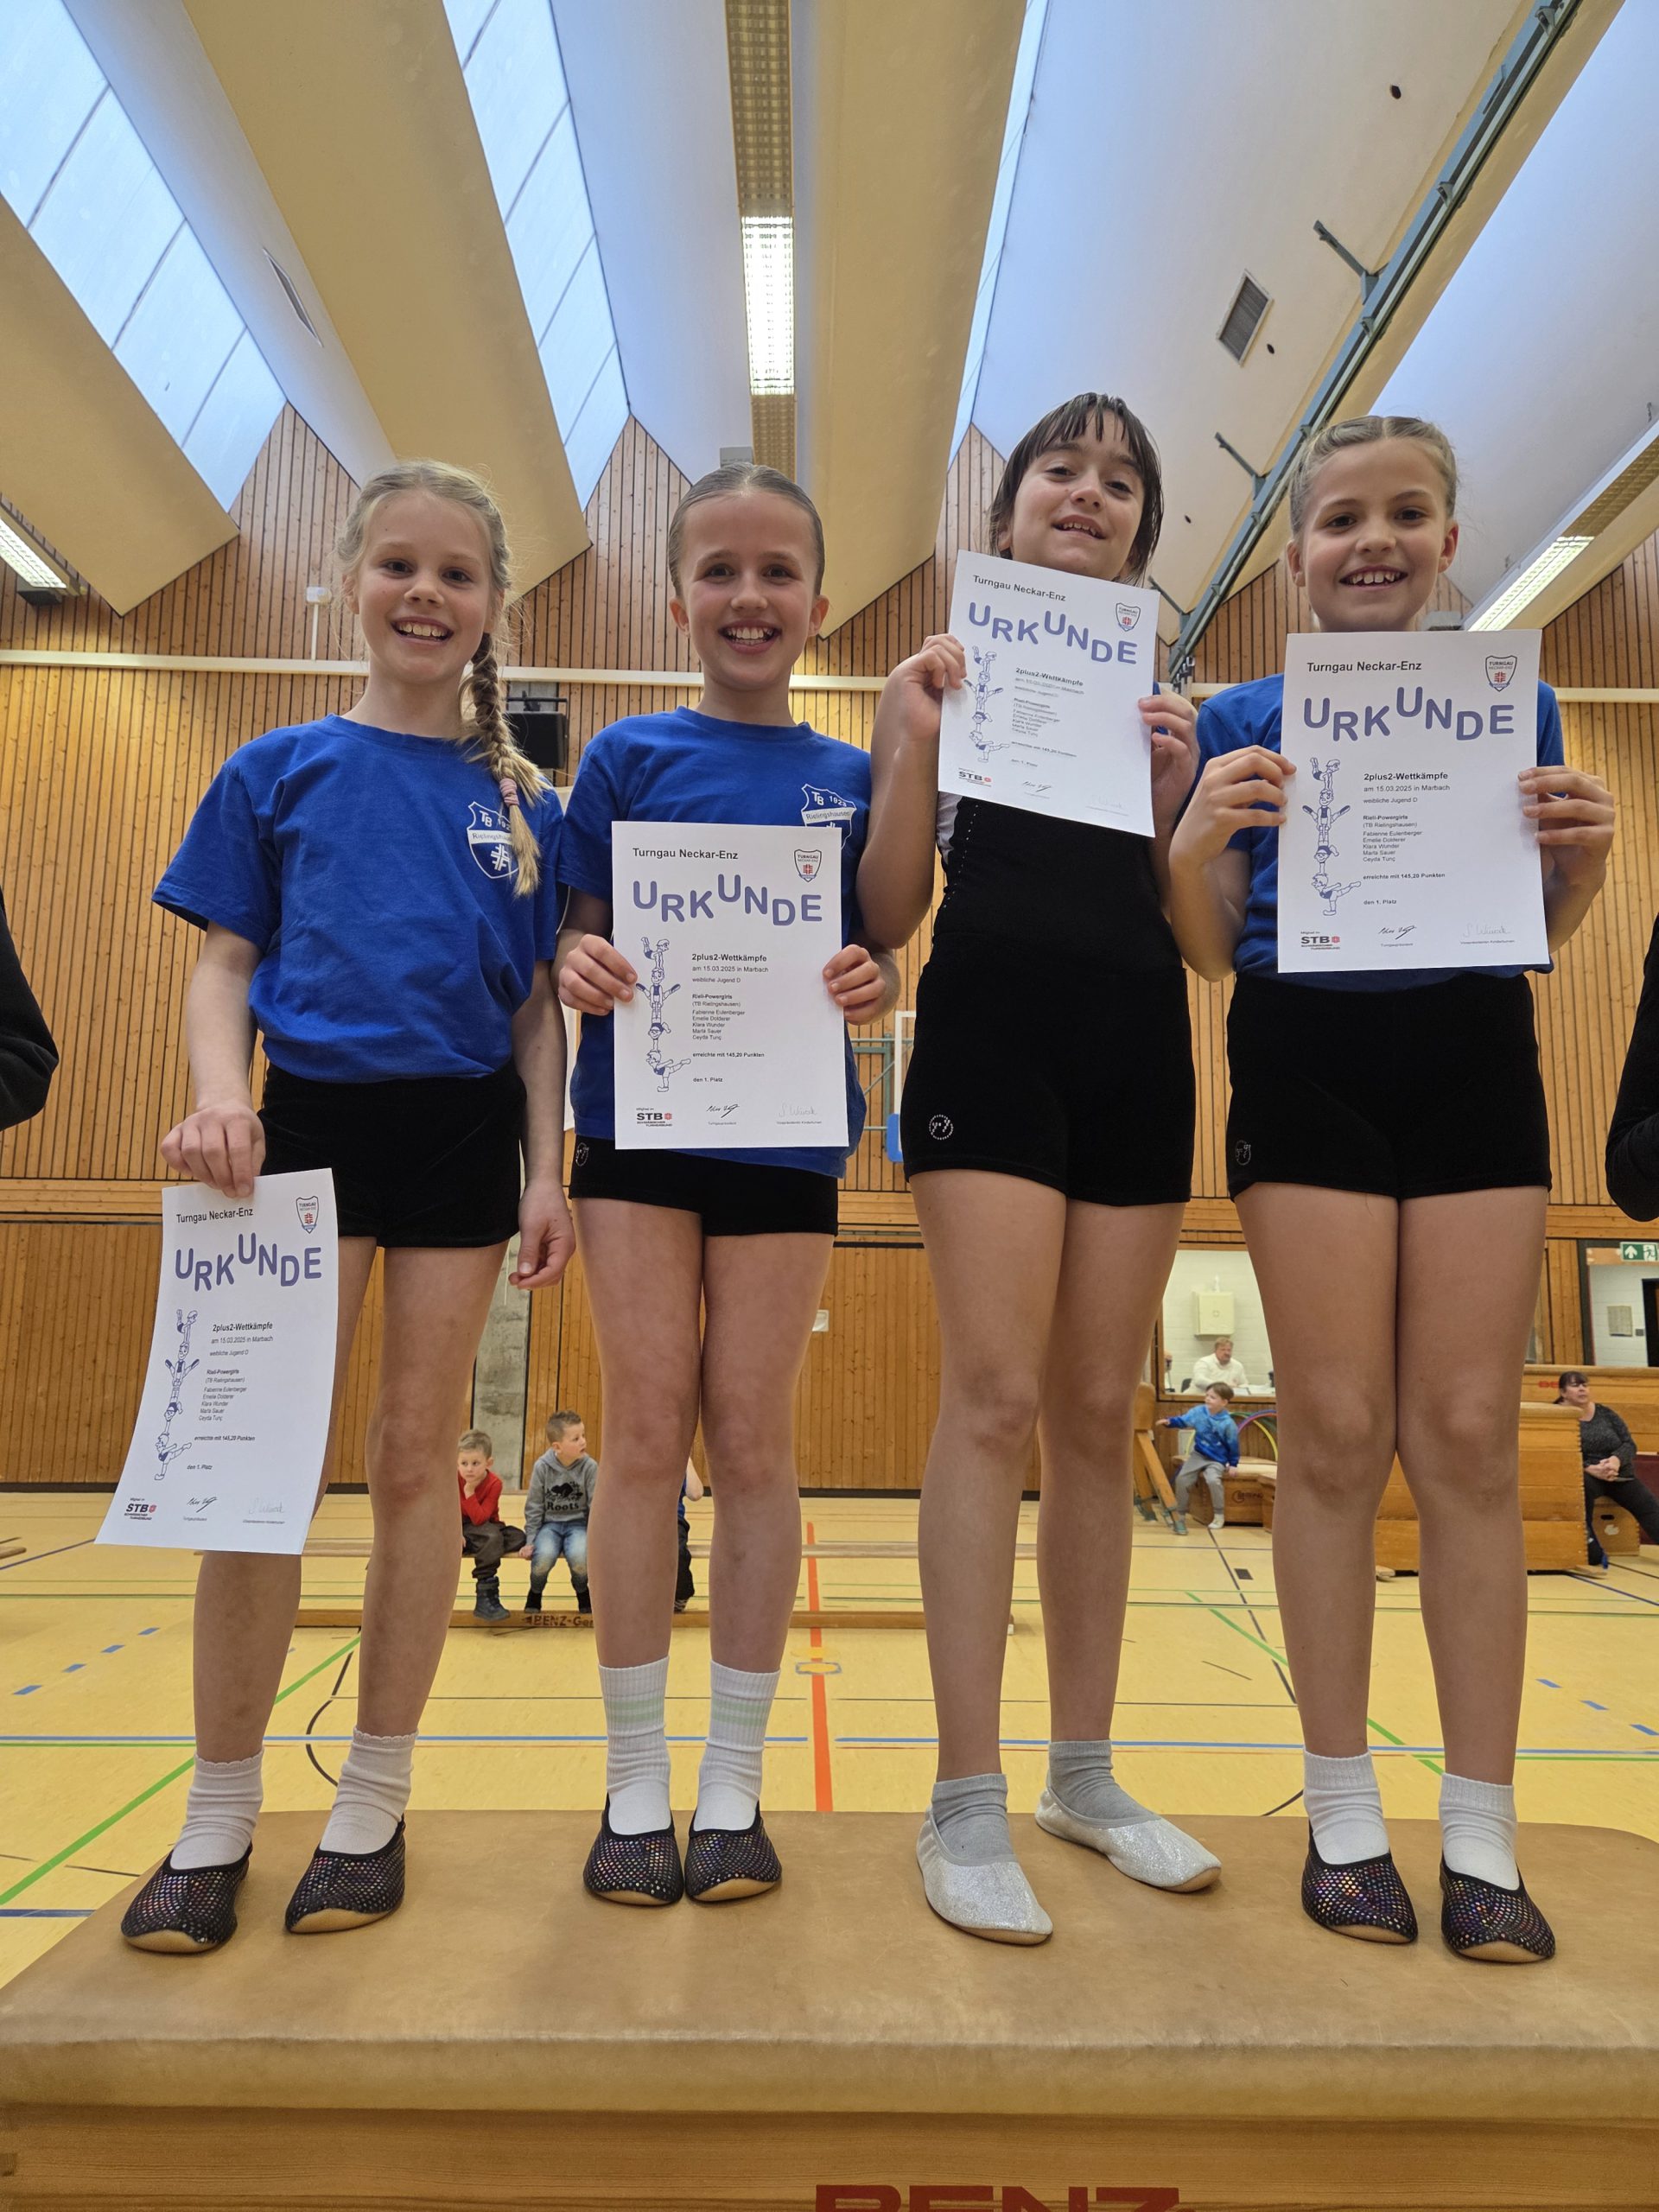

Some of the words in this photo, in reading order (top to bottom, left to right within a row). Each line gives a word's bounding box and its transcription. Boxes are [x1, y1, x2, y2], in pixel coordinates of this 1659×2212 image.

[973, 575, 1011, 590] Turngau
[1014, 585, 1066, 602] Neckar-Enz
[968, 602, 1138, 665] URKUNDE
[1307, 662, 1353, 673] Turngau
[1357, 661, 1422, 672] Neckar-Enz
[1304, 687, 1514, 742] URKUNDE
[959, 771, 983, 781] STB
[1364, 772, 1448, 782] 2plus2-Wettkämpfe
[811, 791, 824, 806] TB
[479, 810, 492, 827] TB
[633, 848, 676, 859] Turngau
[679, 849, 738, 860] Neckar-Enz
[633, 874, 822, 926] URKUNDE
[1301, 936, 1330, 944] STB
[691, 953, 767, 963] 2plus2-Wettkämpfe
[636, 1112, 663, 1121] STB
[176, 1214, 207, 1224] Turngau
[209, 1208, 253, 1220] Neckar-Enz
[175, 1232, 322, 1292] URKUNDE
[213, 1322, 273, 1333] 2plus2-Wettkämpfe
[126, 1503, 149, 1513] STB
[547, 1502, 579, 1512] Roots
